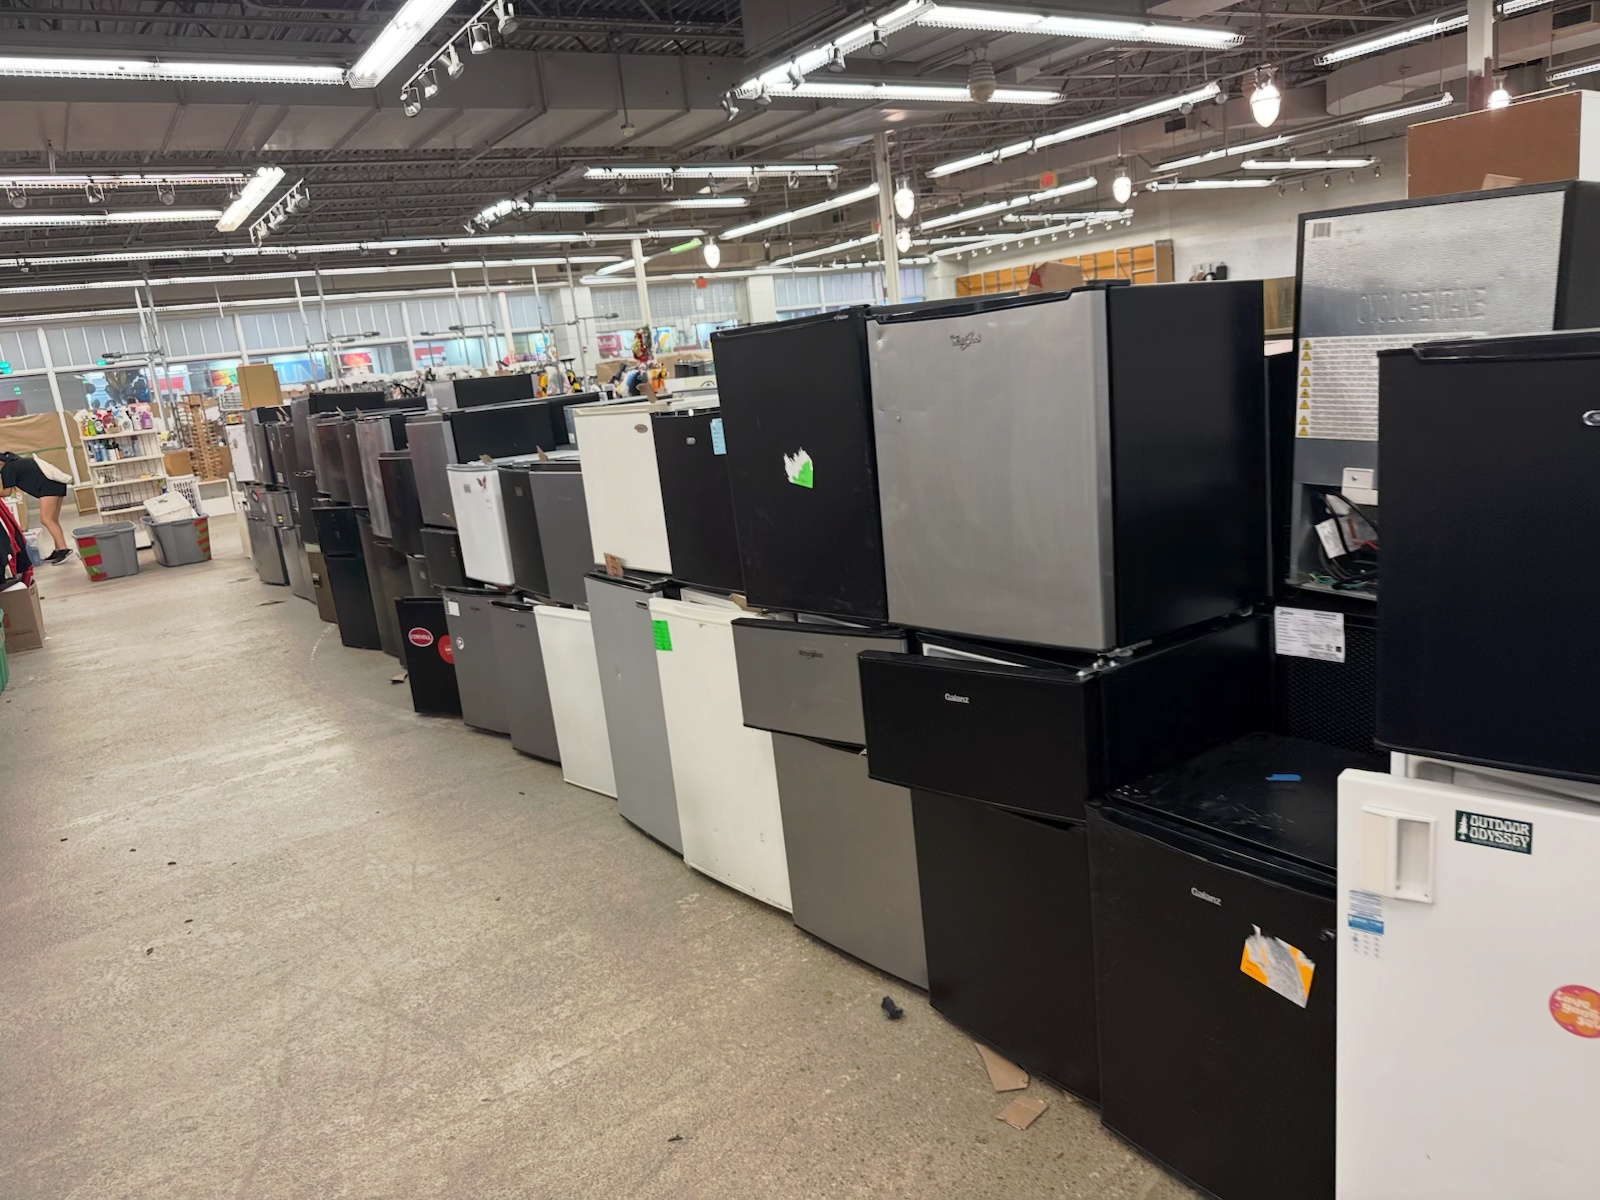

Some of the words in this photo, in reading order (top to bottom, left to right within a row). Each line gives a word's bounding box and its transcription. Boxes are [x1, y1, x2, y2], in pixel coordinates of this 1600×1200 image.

[944, 692, 970, 704] Galanz
[1469, 814, 1531, 836] OUTDOOR
[1469, 826, 1531, 848] ODYSSEY
[1190, 887, 1222, 906] Galanz
